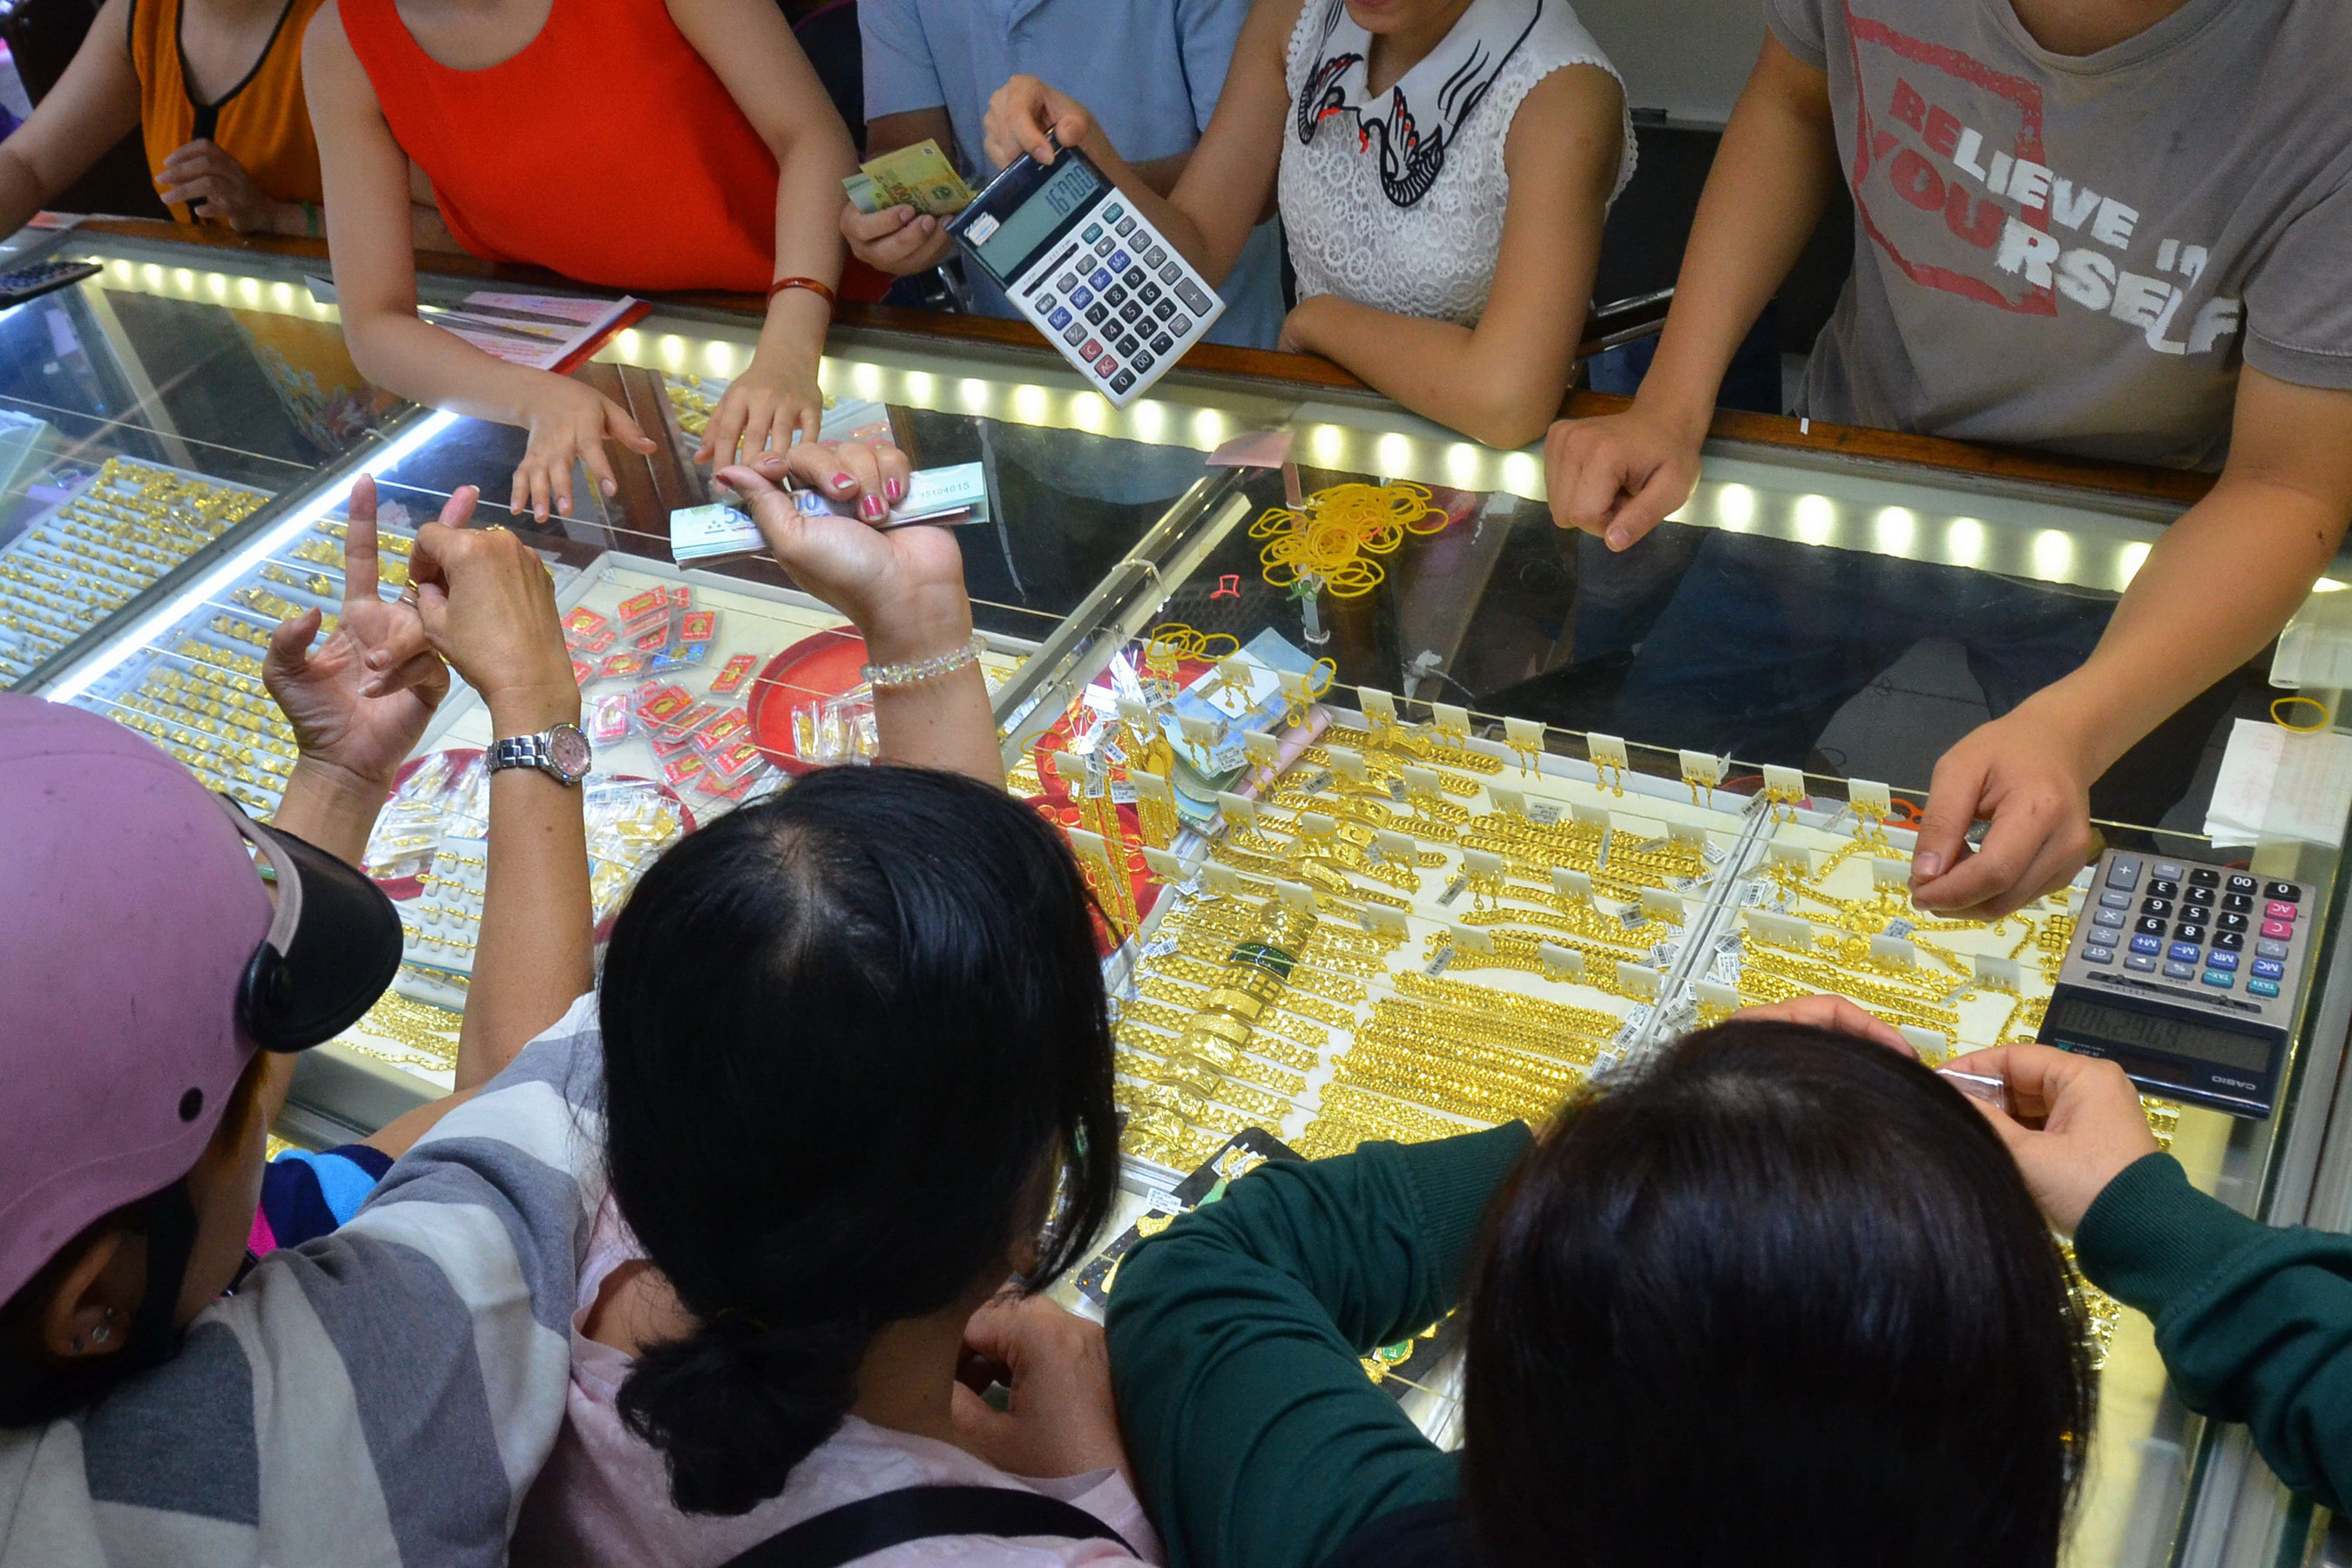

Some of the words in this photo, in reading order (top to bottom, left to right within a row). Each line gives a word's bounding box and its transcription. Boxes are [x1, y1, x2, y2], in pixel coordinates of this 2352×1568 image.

[1889, 77, 2140, 251] BELIEVE
[1112, 290, 1121, 301] 8
[1130, 272, 1139, 282] 9
[1109, 324, 1118, 335] 4
[1126, 307, 1136, 317] 5
[1146, 287, 1155, 298] 6
[1141, 322, 1152, 334] 2
[1161, 305, 1171, 314] 3
[2157, 882, 2168, 892] 3
[2194, 889, 2207, 899] 2
[2152, 900, 2163, 910] 6
[2189, 907, 2200, 918] 5
[2228, 914, 2240, 924] 4
[2146, 919, 2158, 929] 9
[2184, 925, 2196, 936] 8
[2222, 934, 2234, 944] 7
[2211, 1075, 2257, 1091] CASIO
